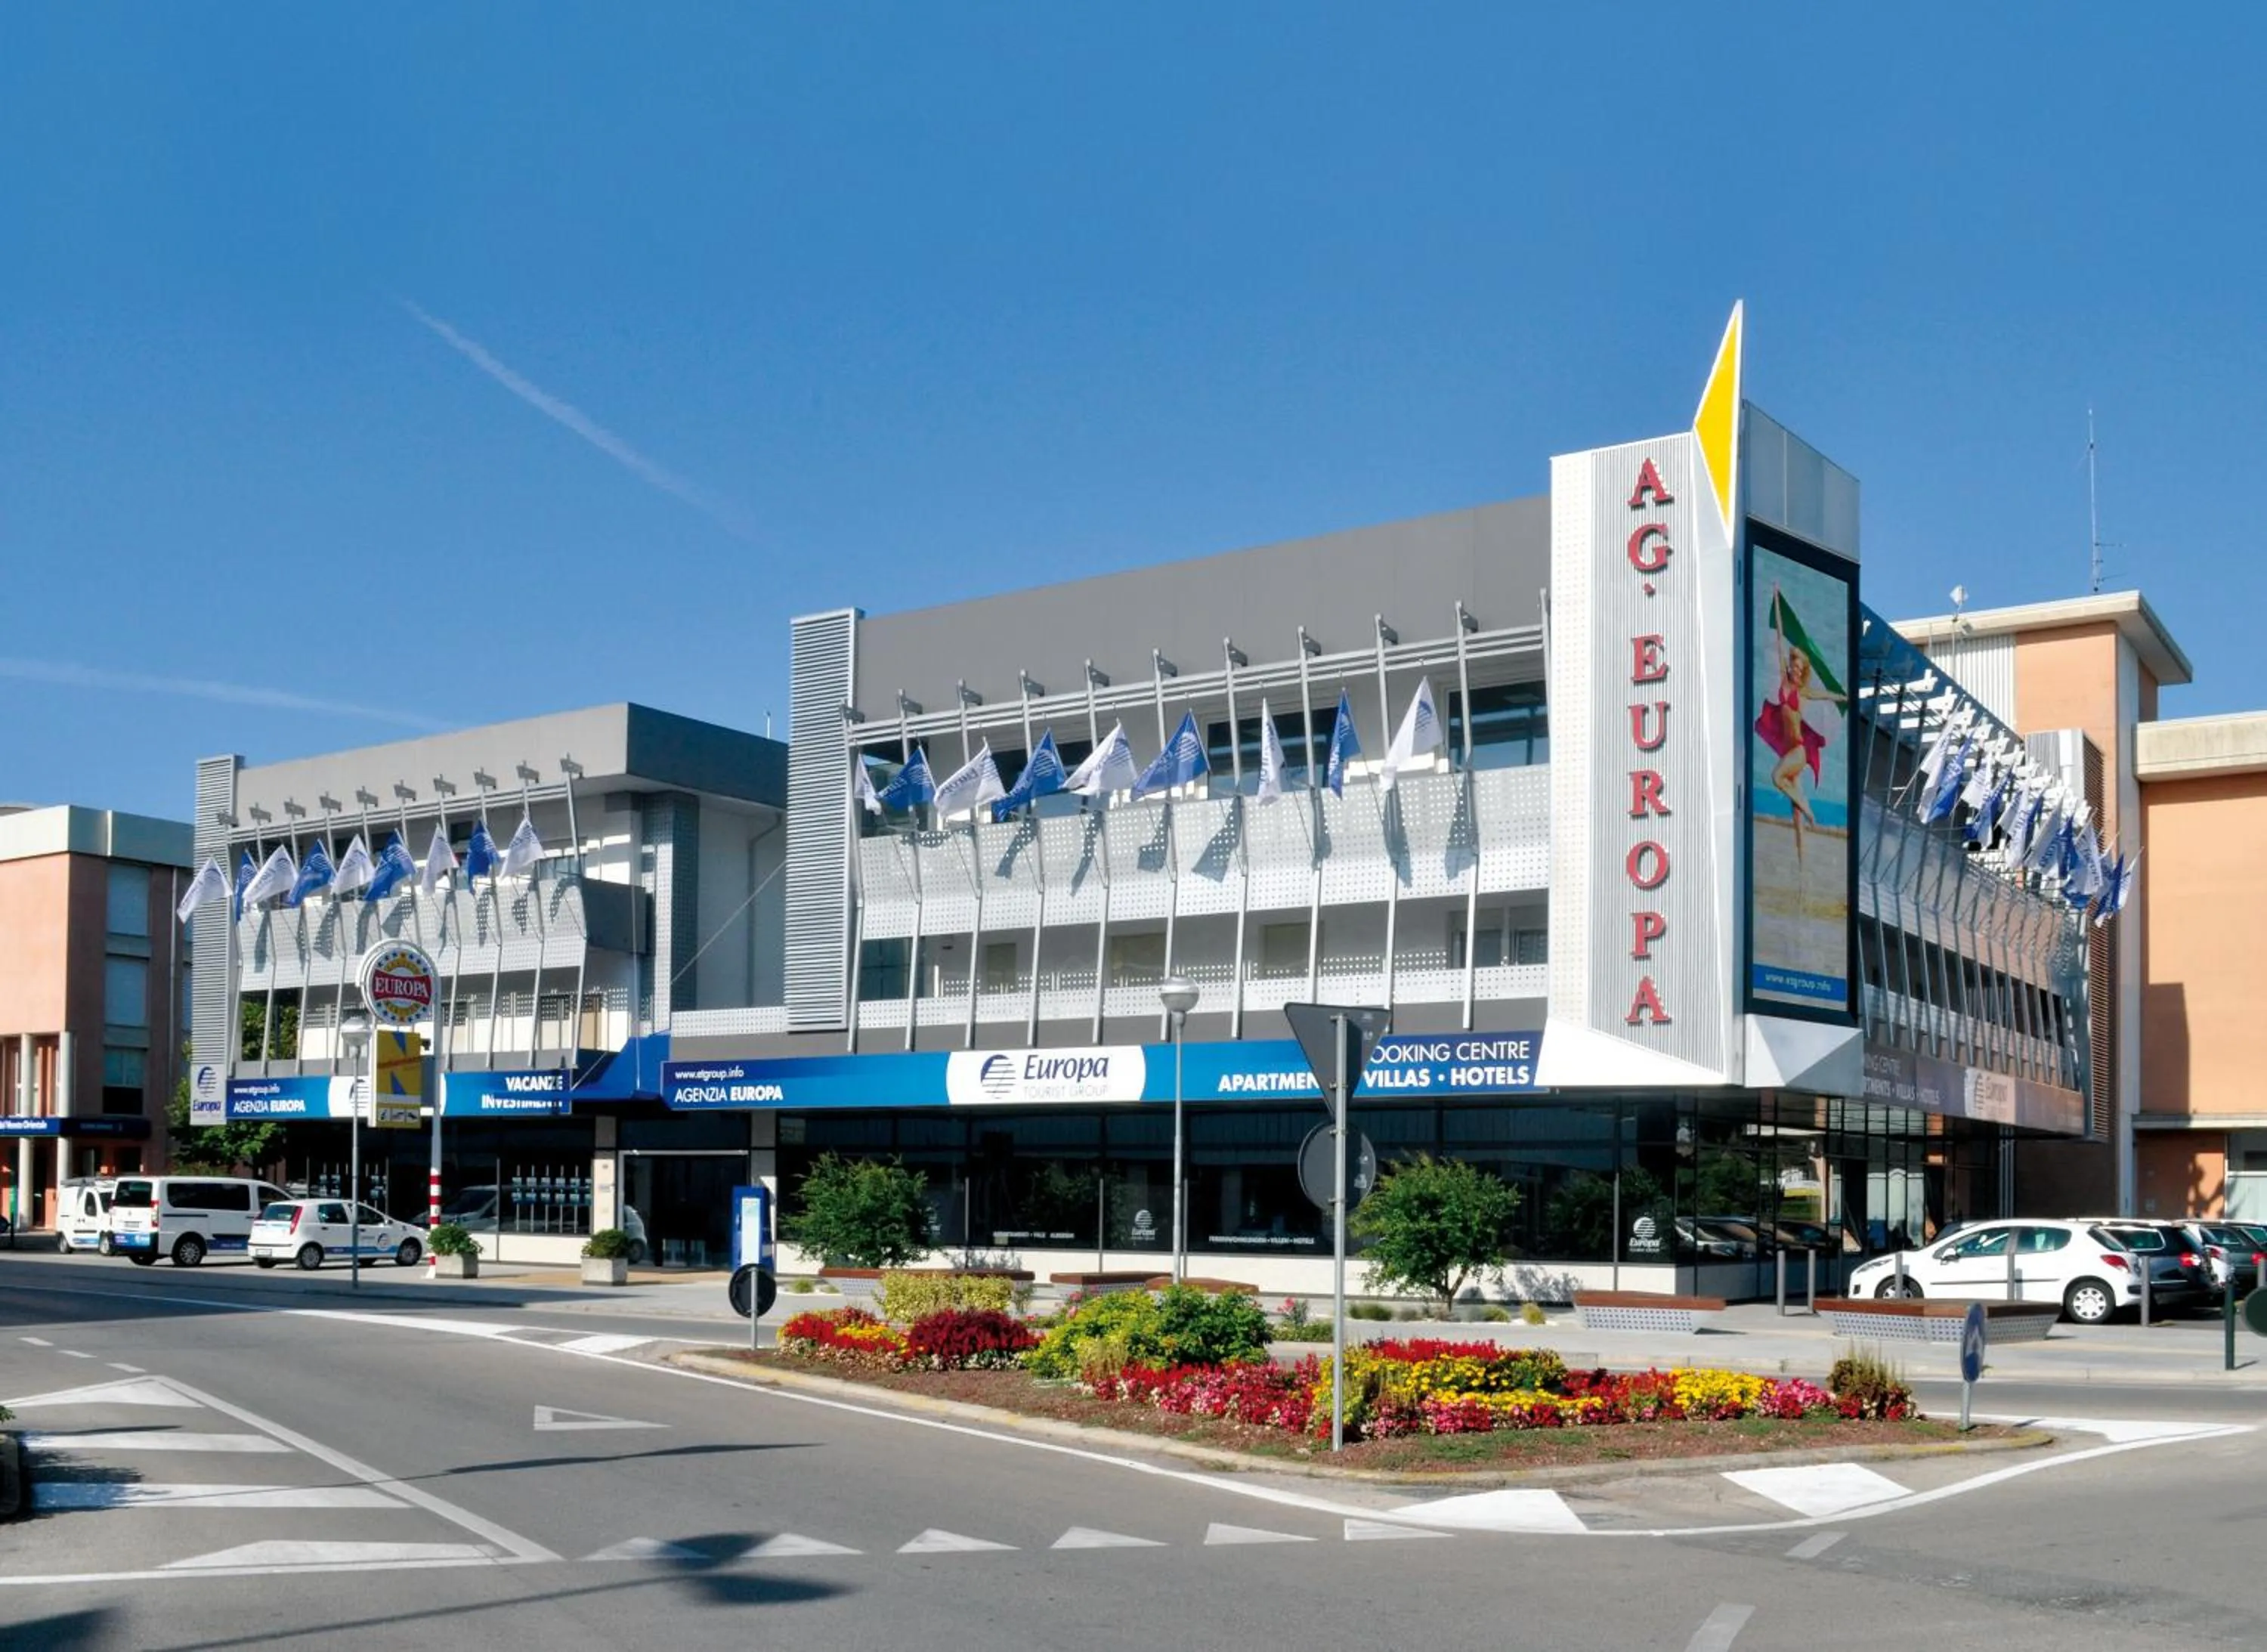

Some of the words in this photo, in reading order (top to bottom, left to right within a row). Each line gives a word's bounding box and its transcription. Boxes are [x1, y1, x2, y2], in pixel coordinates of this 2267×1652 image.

[1625, 633, 1673, 1026] EUROPA
[375, 977, 430, 998] EUROPA
[1371, 1044, 1451, 1064] OOKING
[1456, 1040, 1531, 1061] CENTRE
[1024, 1054, 1110, 1083] Europa
[1217, 1072, 1320, 1091] APARTMEN
[1363, 1068, 1431, 1088] VILLAS
[1450, 1066, 1530, 1086] HOTELS
[505, 1075, 564, 1091] VACANZE
[1025, 1086, 1065, 1099] TOURIST
[1070, 1084, 1109, 1097] GROUP
[674, 1087, 728, 1103] AGENZIA
[730, 1084, 784, 1101] EUROPA
[193, 1099, 222, 1113] Europa
[234, 1101, 269, 1113] AGENZIA
[270, 1100, 306, 1112] EUROPA
